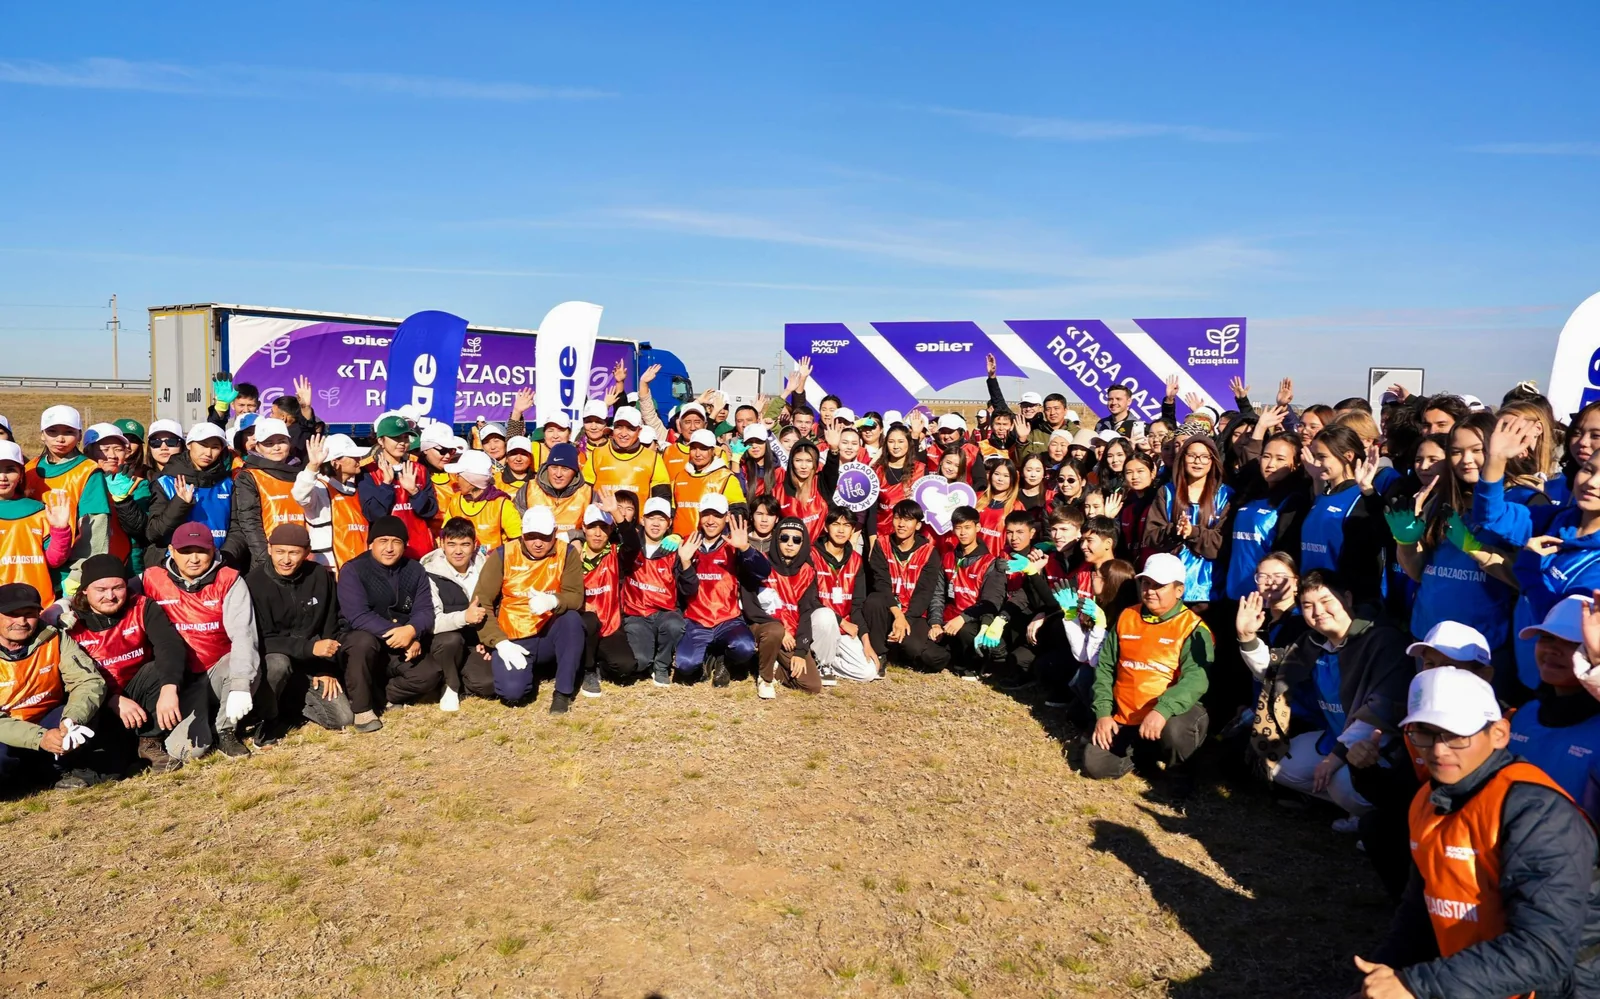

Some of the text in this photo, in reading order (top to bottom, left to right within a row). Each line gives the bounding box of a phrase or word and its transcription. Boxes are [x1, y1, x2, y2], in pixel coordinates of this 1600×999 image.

[1188, 347, 1219, 357] Таза
[1188, 357, 1239, 366] Qazaqstan
[1437, 566, 1487, 583] QAZAQSTAN
